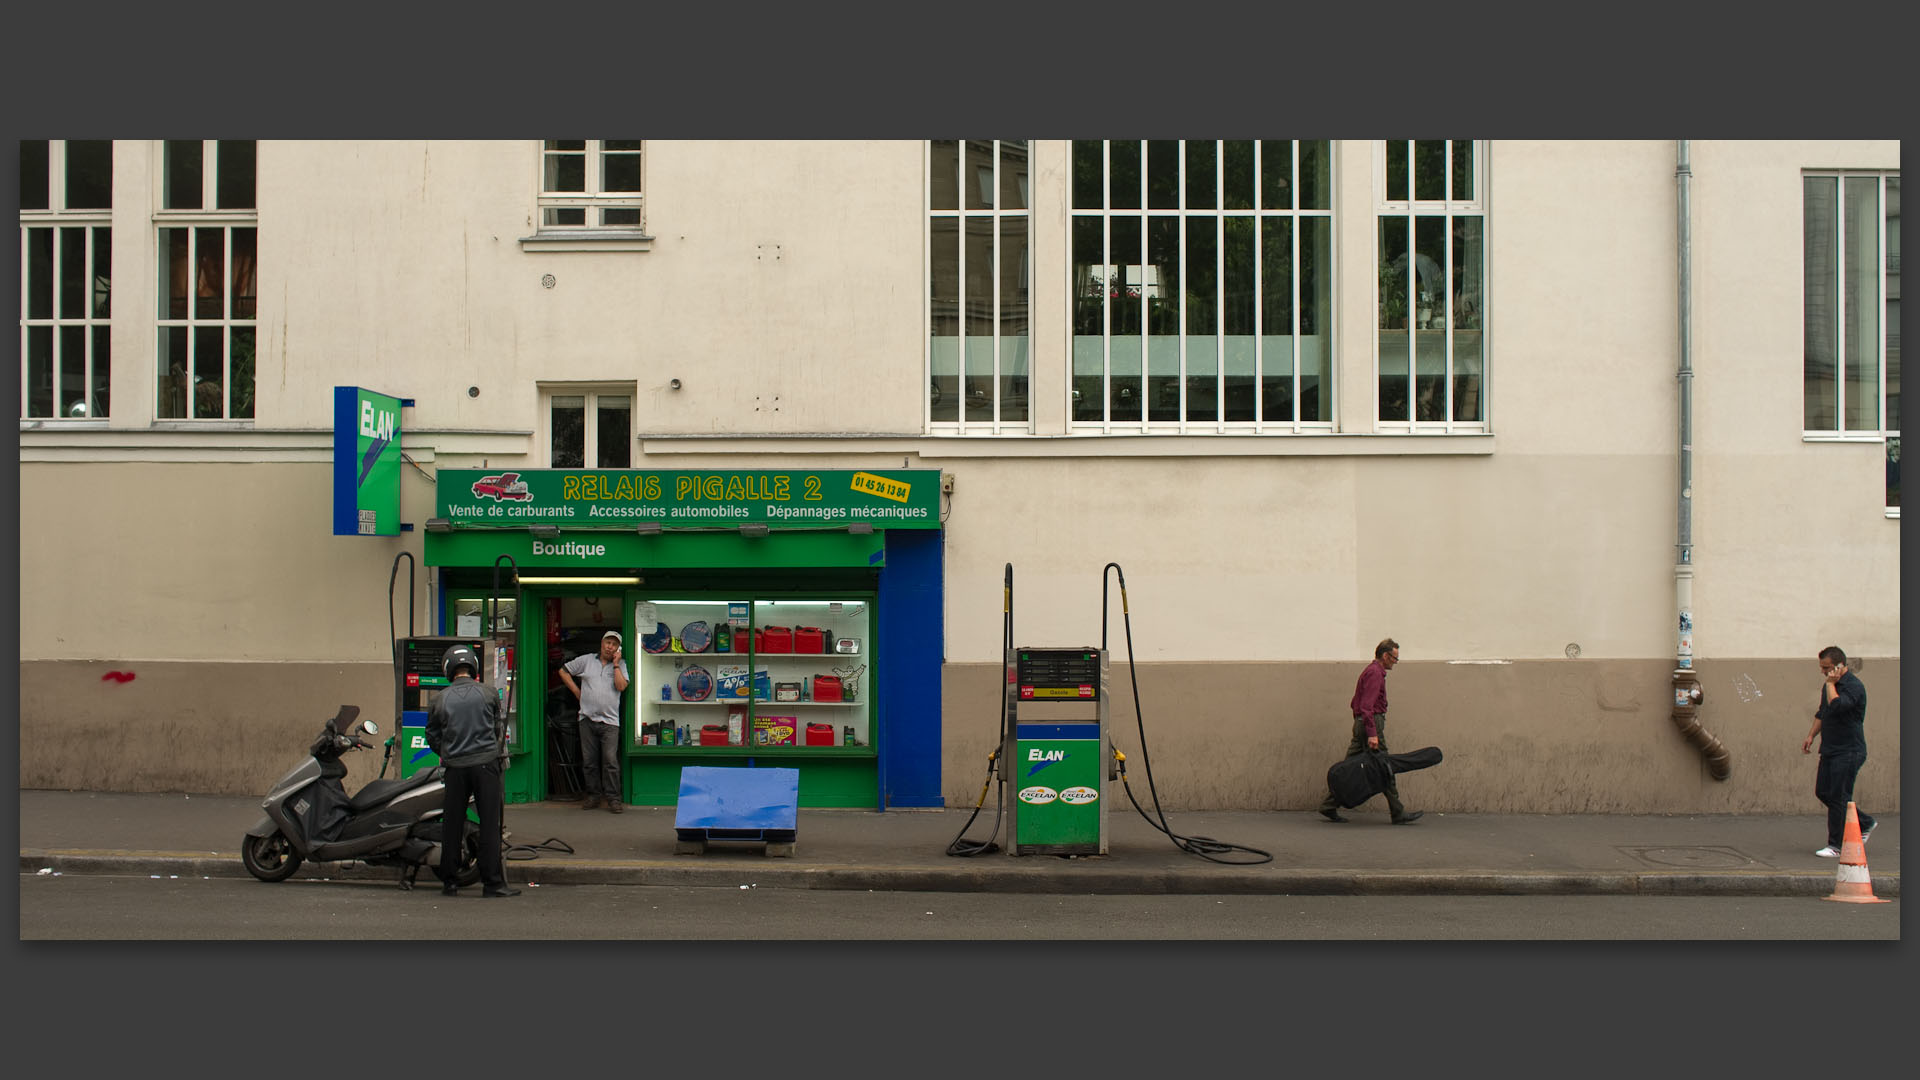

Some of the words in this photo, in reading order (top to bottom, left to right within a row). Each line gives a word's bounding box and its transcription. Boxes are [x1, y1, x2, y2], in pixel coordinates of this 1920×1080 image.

[360, 399, 394, 442] ELAN
[563, 475, 662, 500] RELAIS
[676, 475, 791, 500] PIGALLE
[803, 475, 823, 500] 2
[855, 477, 864, 487] 01
[865, 479, 875, 490] 45
[875, 482, 885, 493] 26
[887, 484, 896, 496] 13
[448, 504, 484, 517] Vente
[487, 504, 504, 517] de
[507, 504, 575, 517] carburants
[589, 504, 667, 517] Accessoires
[670, 504, 750, 518] automobiles
[766, 504, 847, 520] Dépannages
[850, 504, 928, 520] mécaniques
[532, 541, 606, 559] Boutique
[723, 676, 745, 690] 4%
[411, 735, 430, 748] EL
[1028, 748, 1064, 761] ELAN
